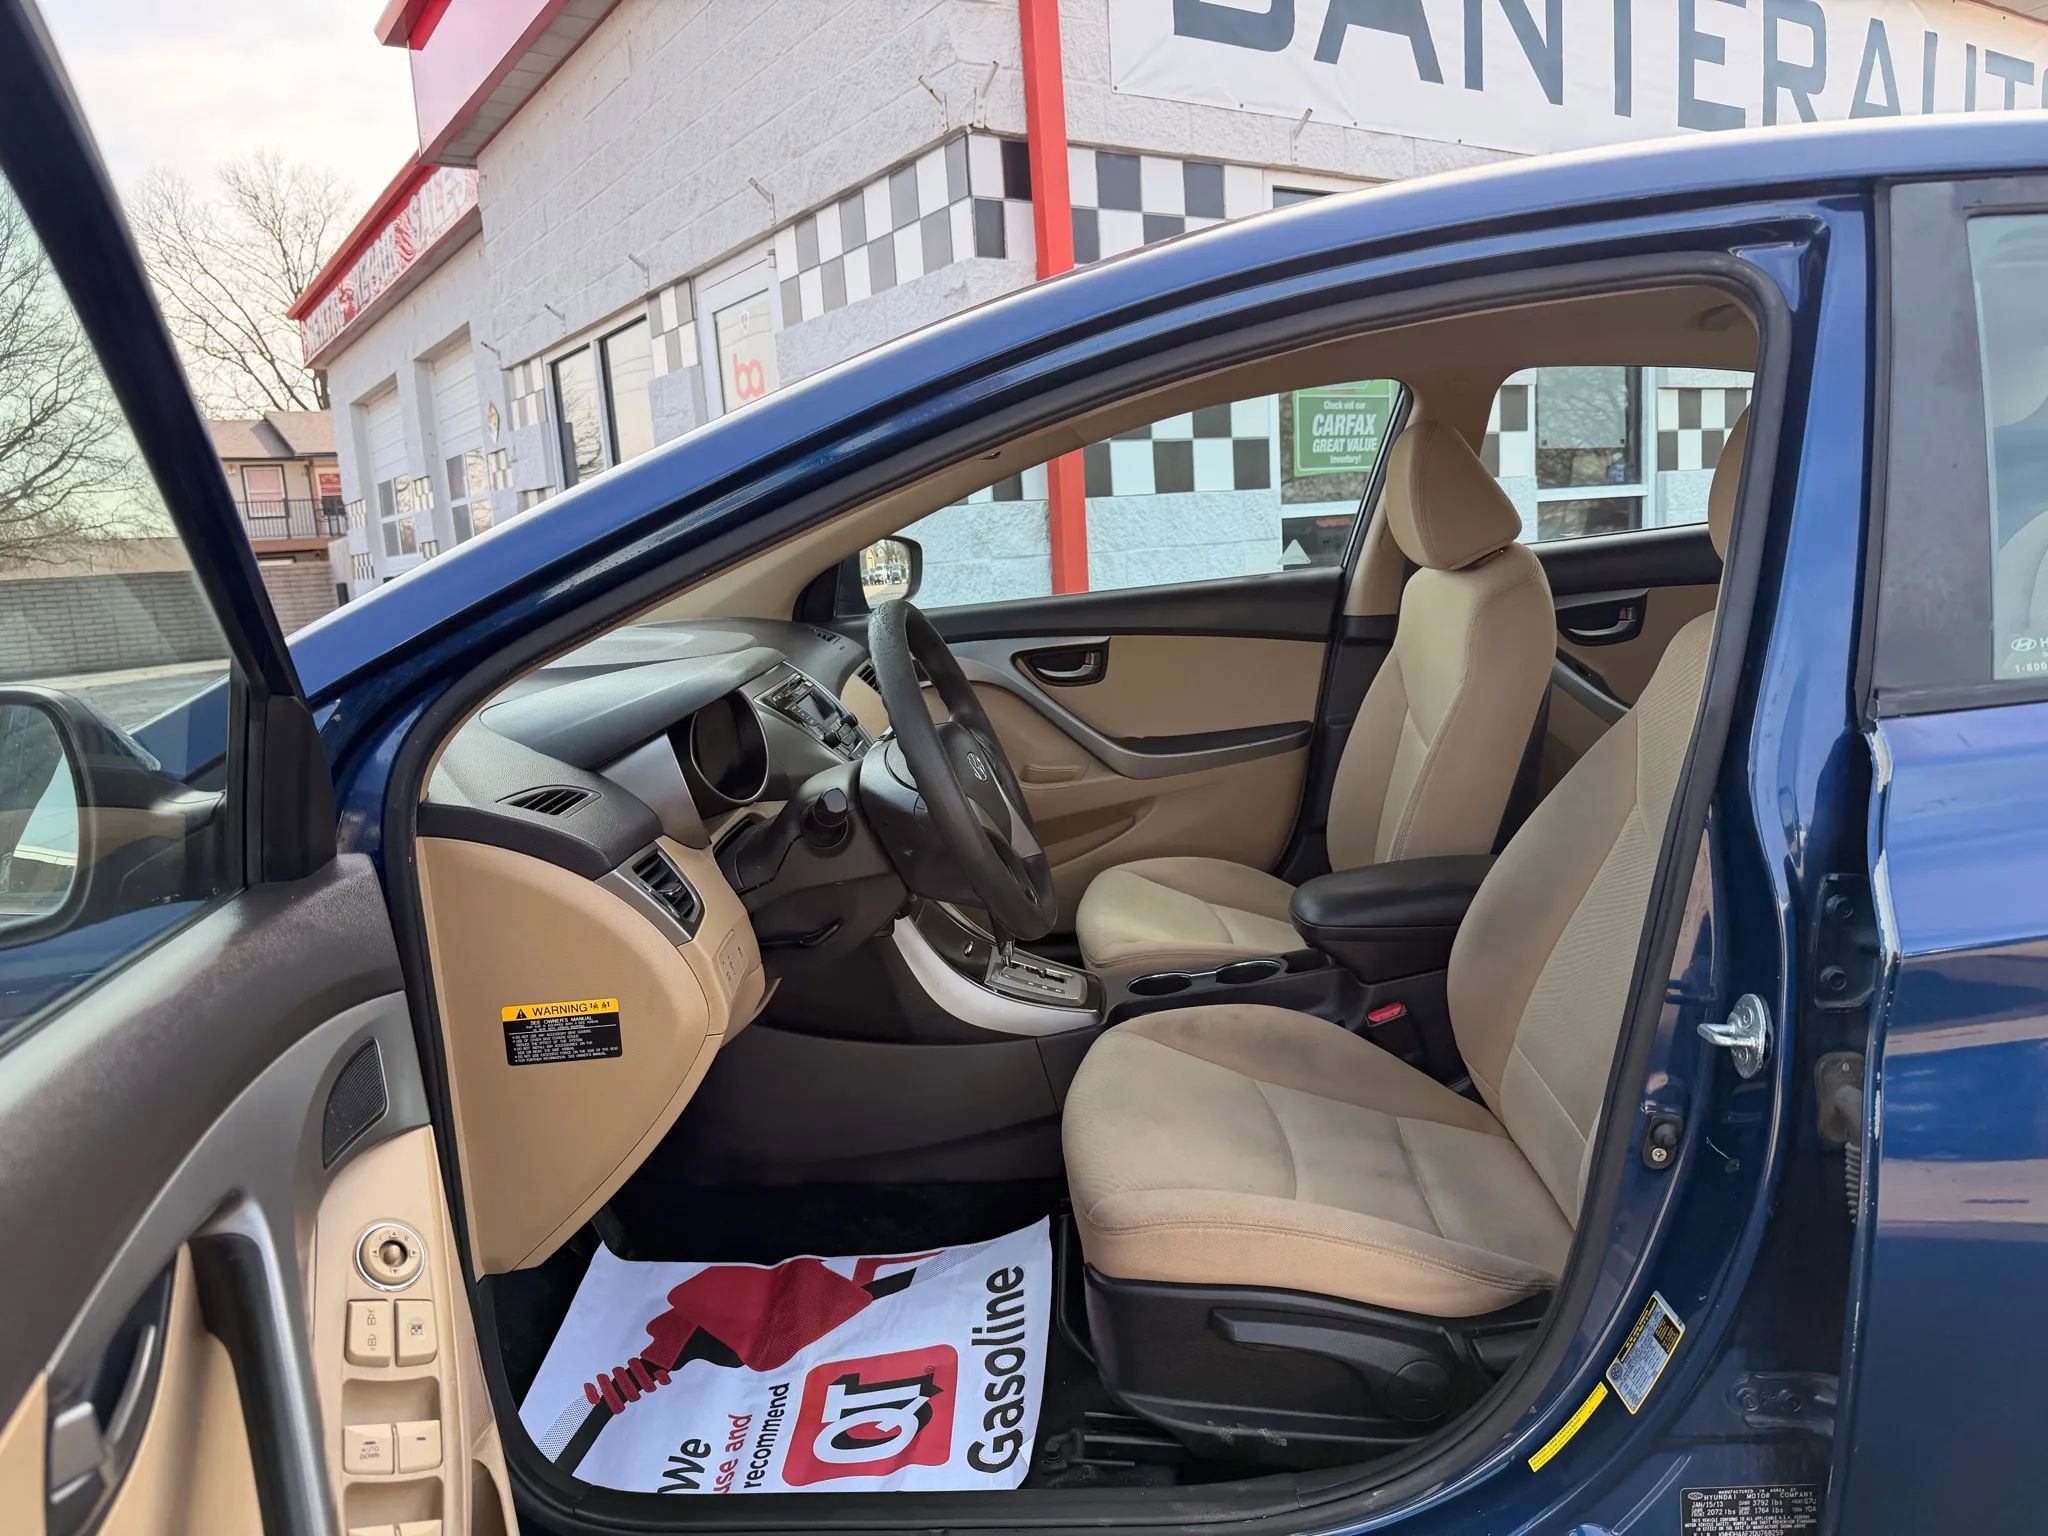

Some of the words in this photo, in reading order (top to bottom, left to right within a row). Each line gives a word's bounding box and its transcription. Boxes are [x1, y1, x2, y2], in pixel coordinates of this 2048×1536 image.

[1323, 400, 1343, 410] Check
[1344, 401, 1354, 410] out
[1355, 402, 1366, 410] our
[1312, 413, 1377, 437] CARFAX
[1312, 438, 1345, 453] GREAT
[1347, 437, 1378, 452] VALUE
[532, 1003, 588, 1016] WARNING
[967, 1265, 1026, 1474] Gasoline
[725, 1414, 752, 1452] and
[743, 1382, 790, 1488] recommend
[657, 1438, 711, 1493] We
[713, 1458, 738, 1494] use
